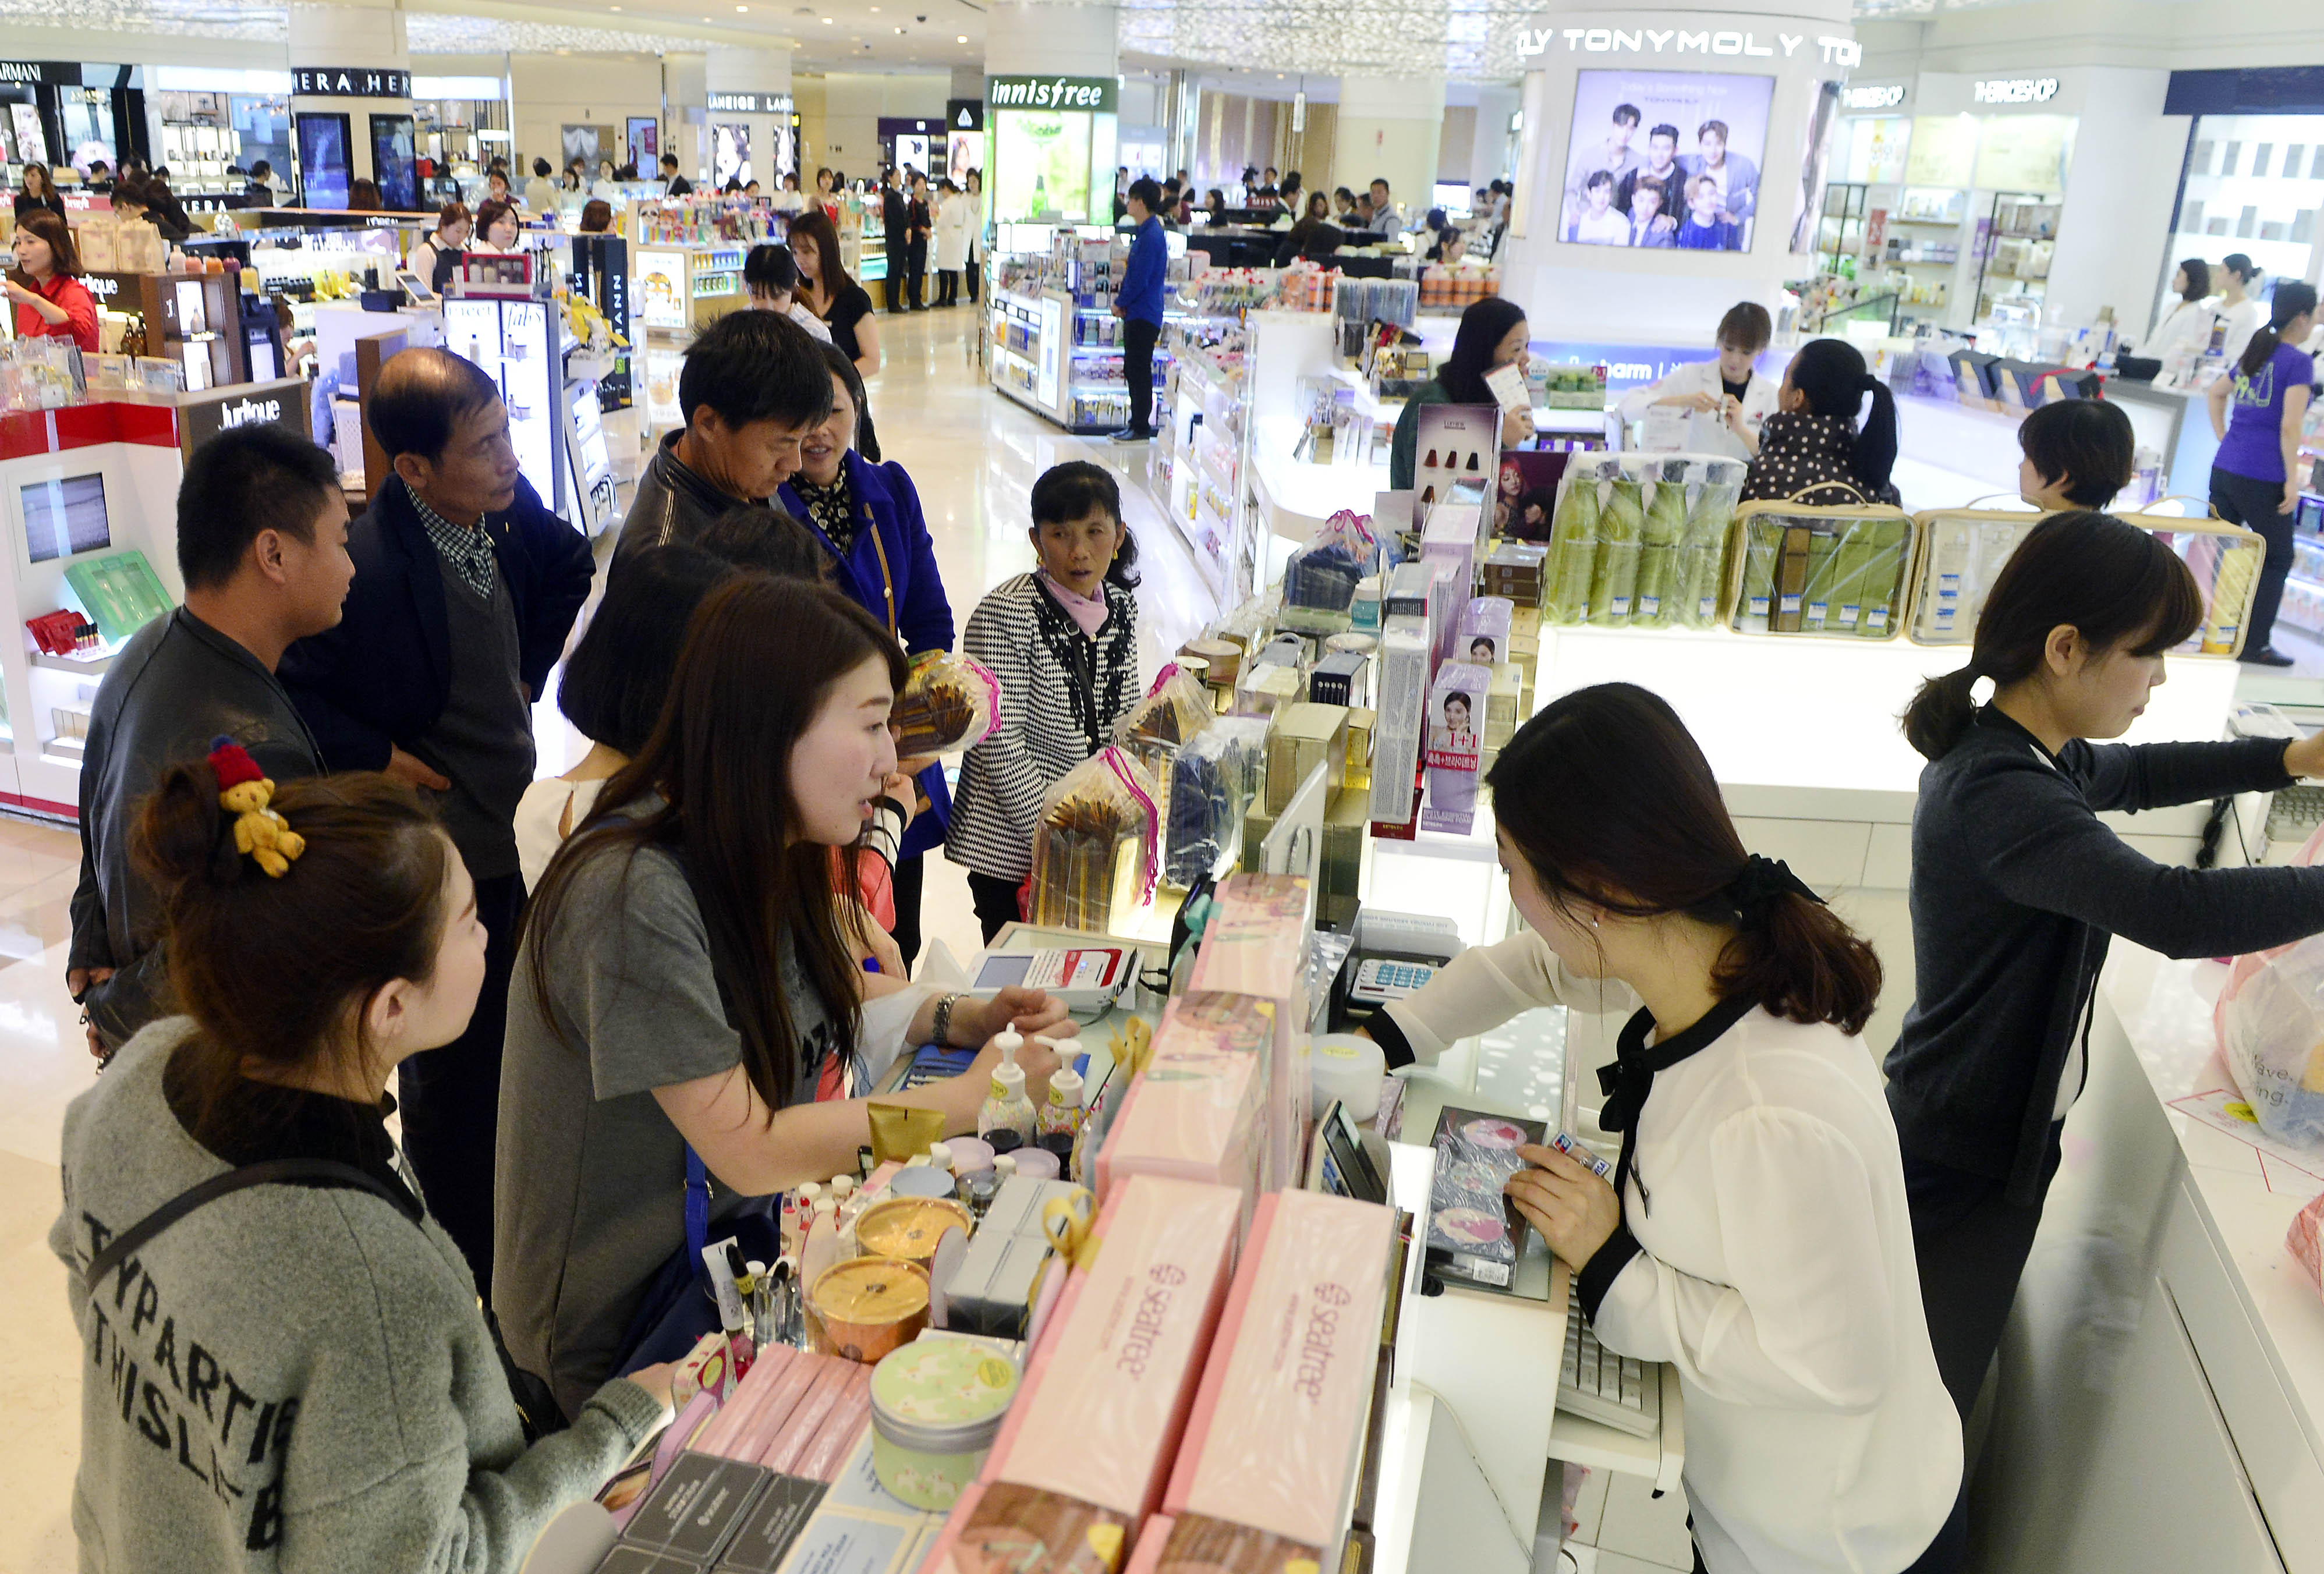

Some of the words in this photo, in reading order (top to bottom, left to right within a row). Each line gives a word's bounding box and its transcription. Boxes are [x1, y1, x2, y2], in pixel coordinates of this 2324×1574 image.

[1563, 29, 1803, 57] TONYMOLY
[708, 95, 756, 111] LANEIGE
[991, 77, 1102, 108] innisfree
[1451, 732, 1477, 748] 1+1
[1117, 1285, 1171, 1380] seatree
[1292, 1304, 1340, 1403] seatree
